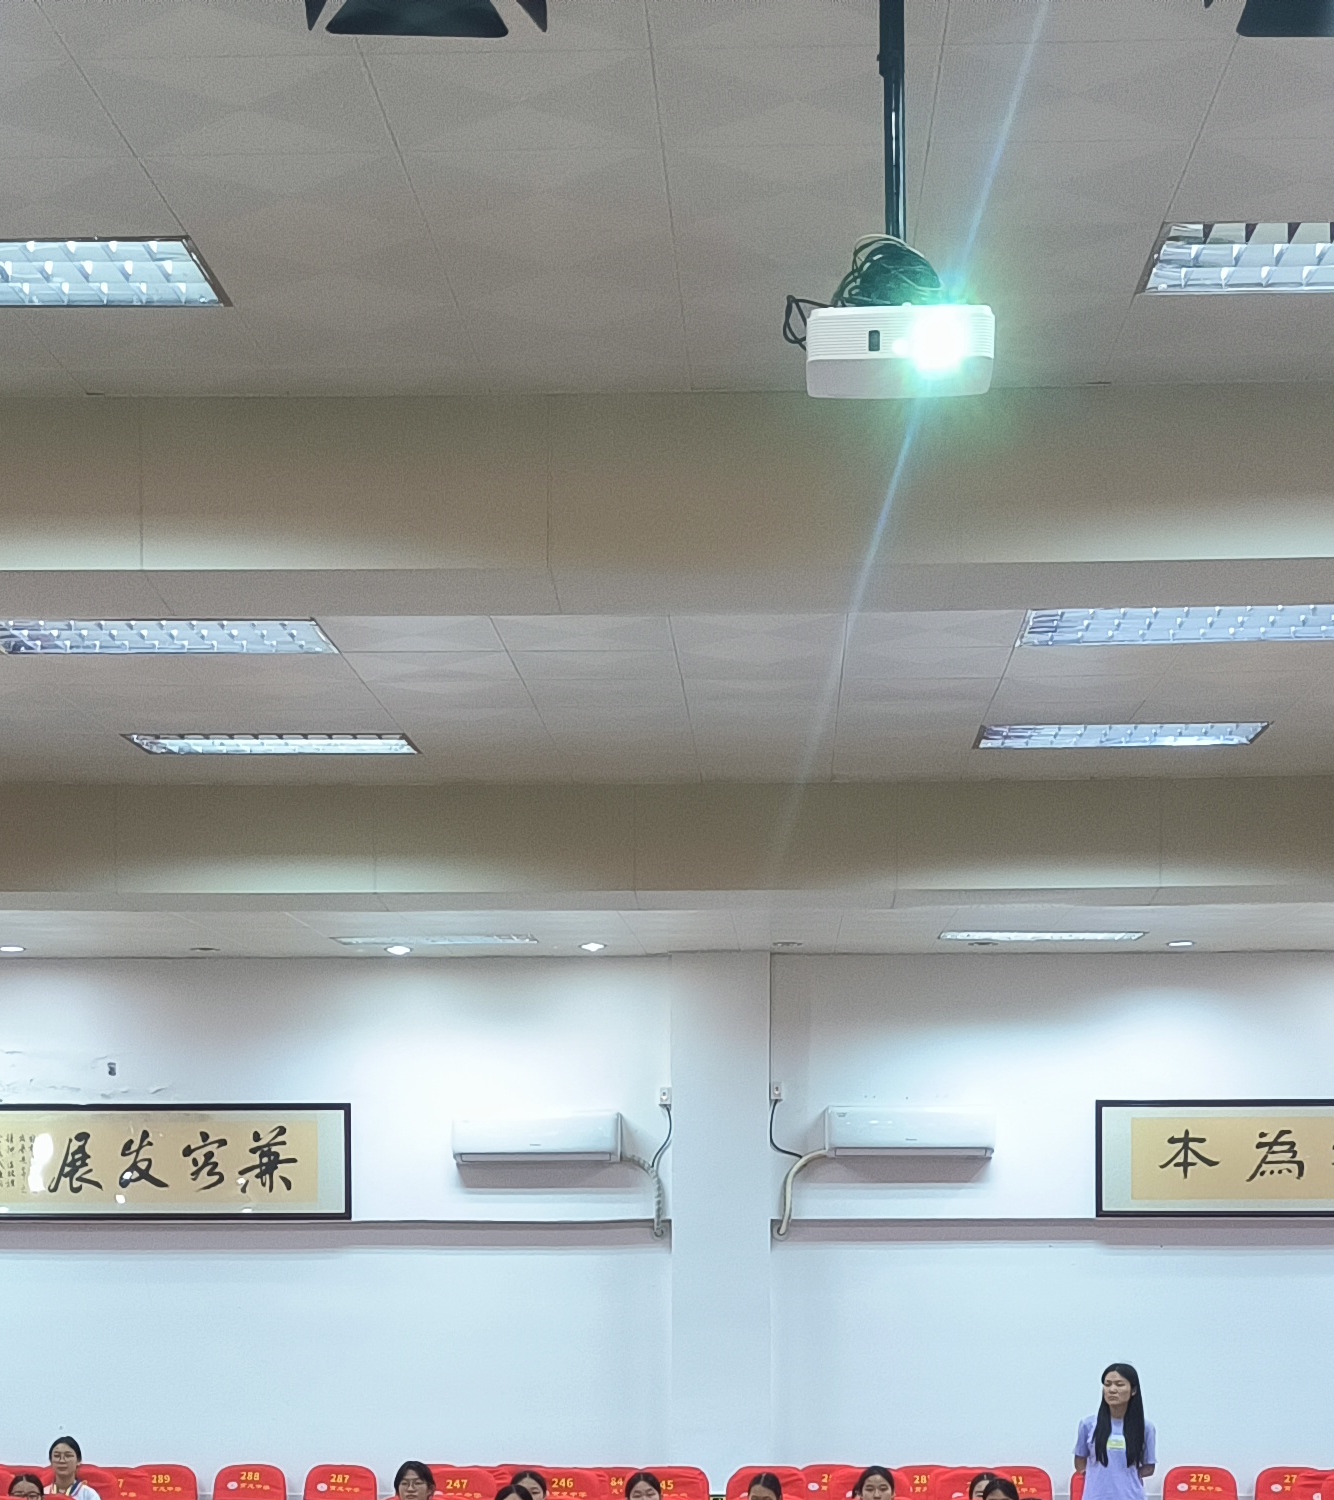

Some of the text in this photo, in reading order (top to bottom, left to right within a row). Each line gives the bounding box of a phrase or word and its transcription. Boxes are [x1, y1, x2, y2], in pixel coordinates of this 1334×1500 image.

[329, 1473, 350, 1483] 287
[551, 1477, 574, 1488] 246
[1189, 1473, 1211, 1483] 279
[445, 1479, 469, 1490] 247
